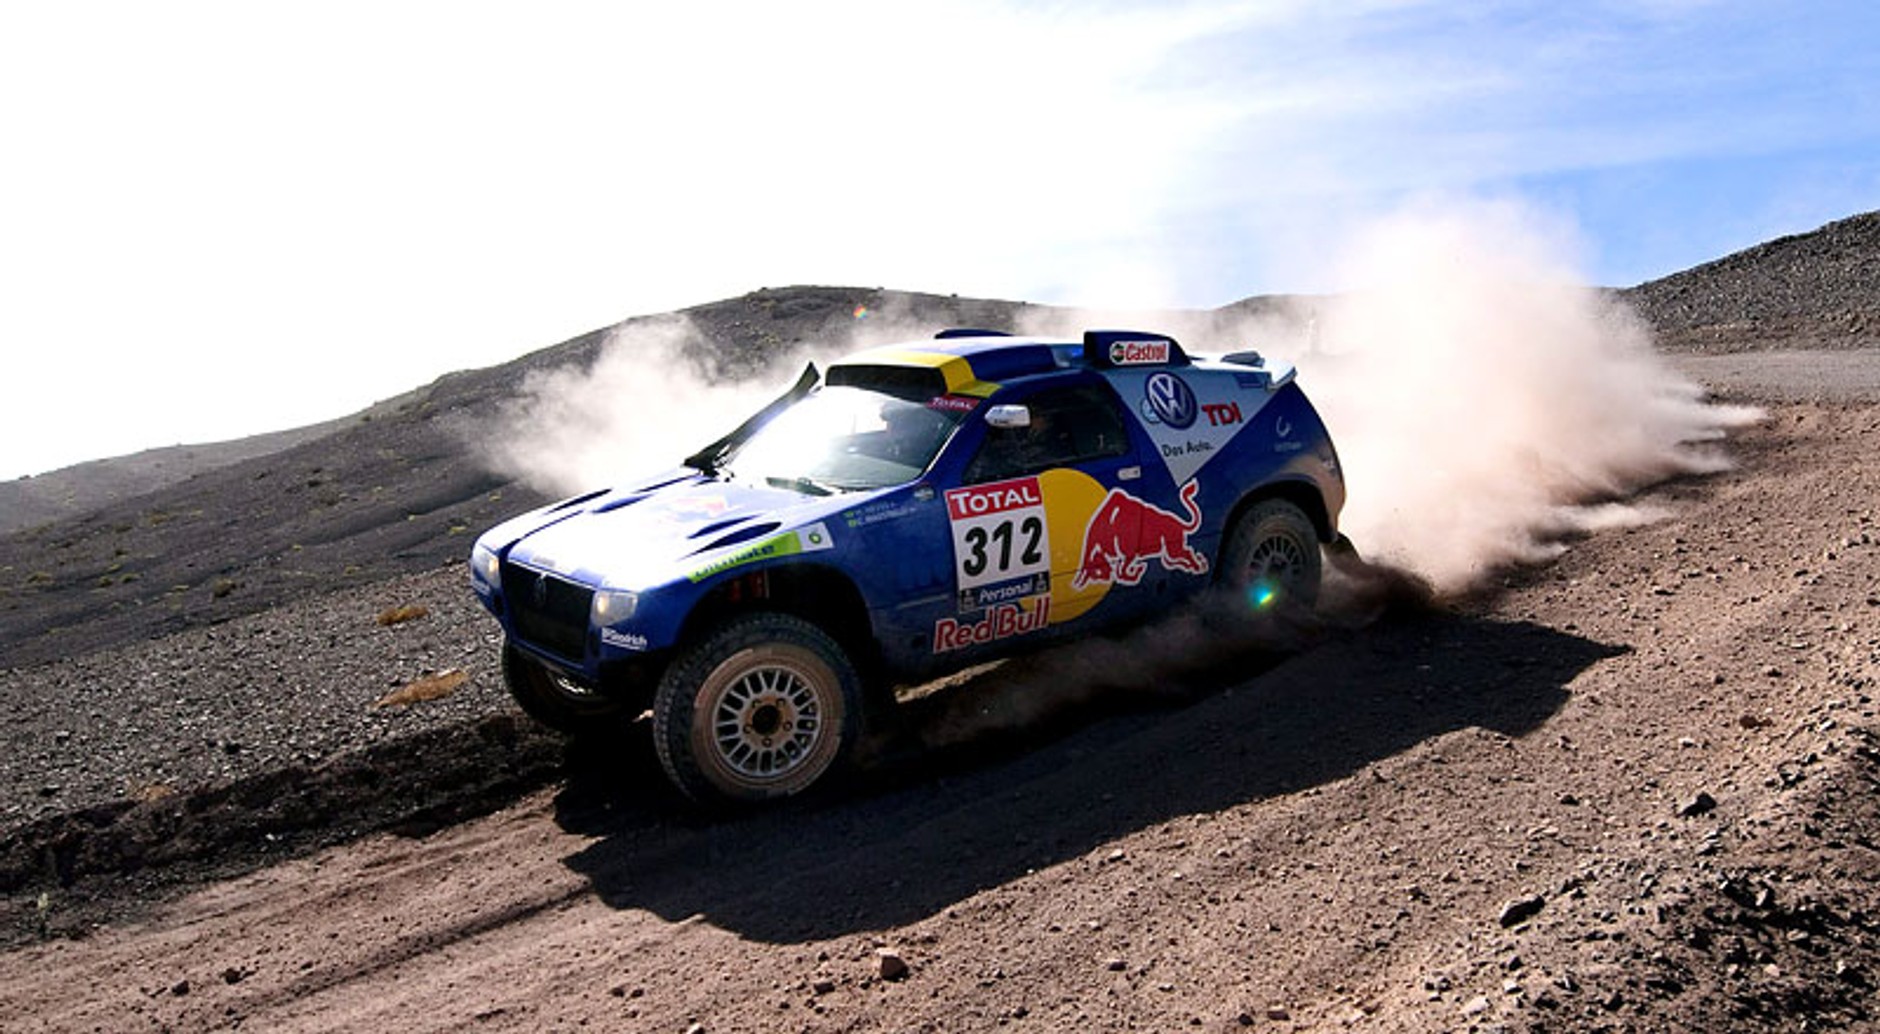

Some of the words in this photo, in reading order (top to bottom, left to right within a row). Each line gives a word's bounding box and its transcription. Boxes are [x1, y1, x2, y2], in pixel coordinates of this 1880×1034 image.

[1125, 341, 1167, 361] Castrol
[1202, 402, 1243, 426] TDI
[1162, 443, 1184, 457] Das
[951, 486, 1040, 514] TOTAL
[963, 516, 1042, 576] 312
[979, 580, 1034, 603] Personal
[933, 604, 994, 654] Red
[997, 597, 1050, 637] Bull
